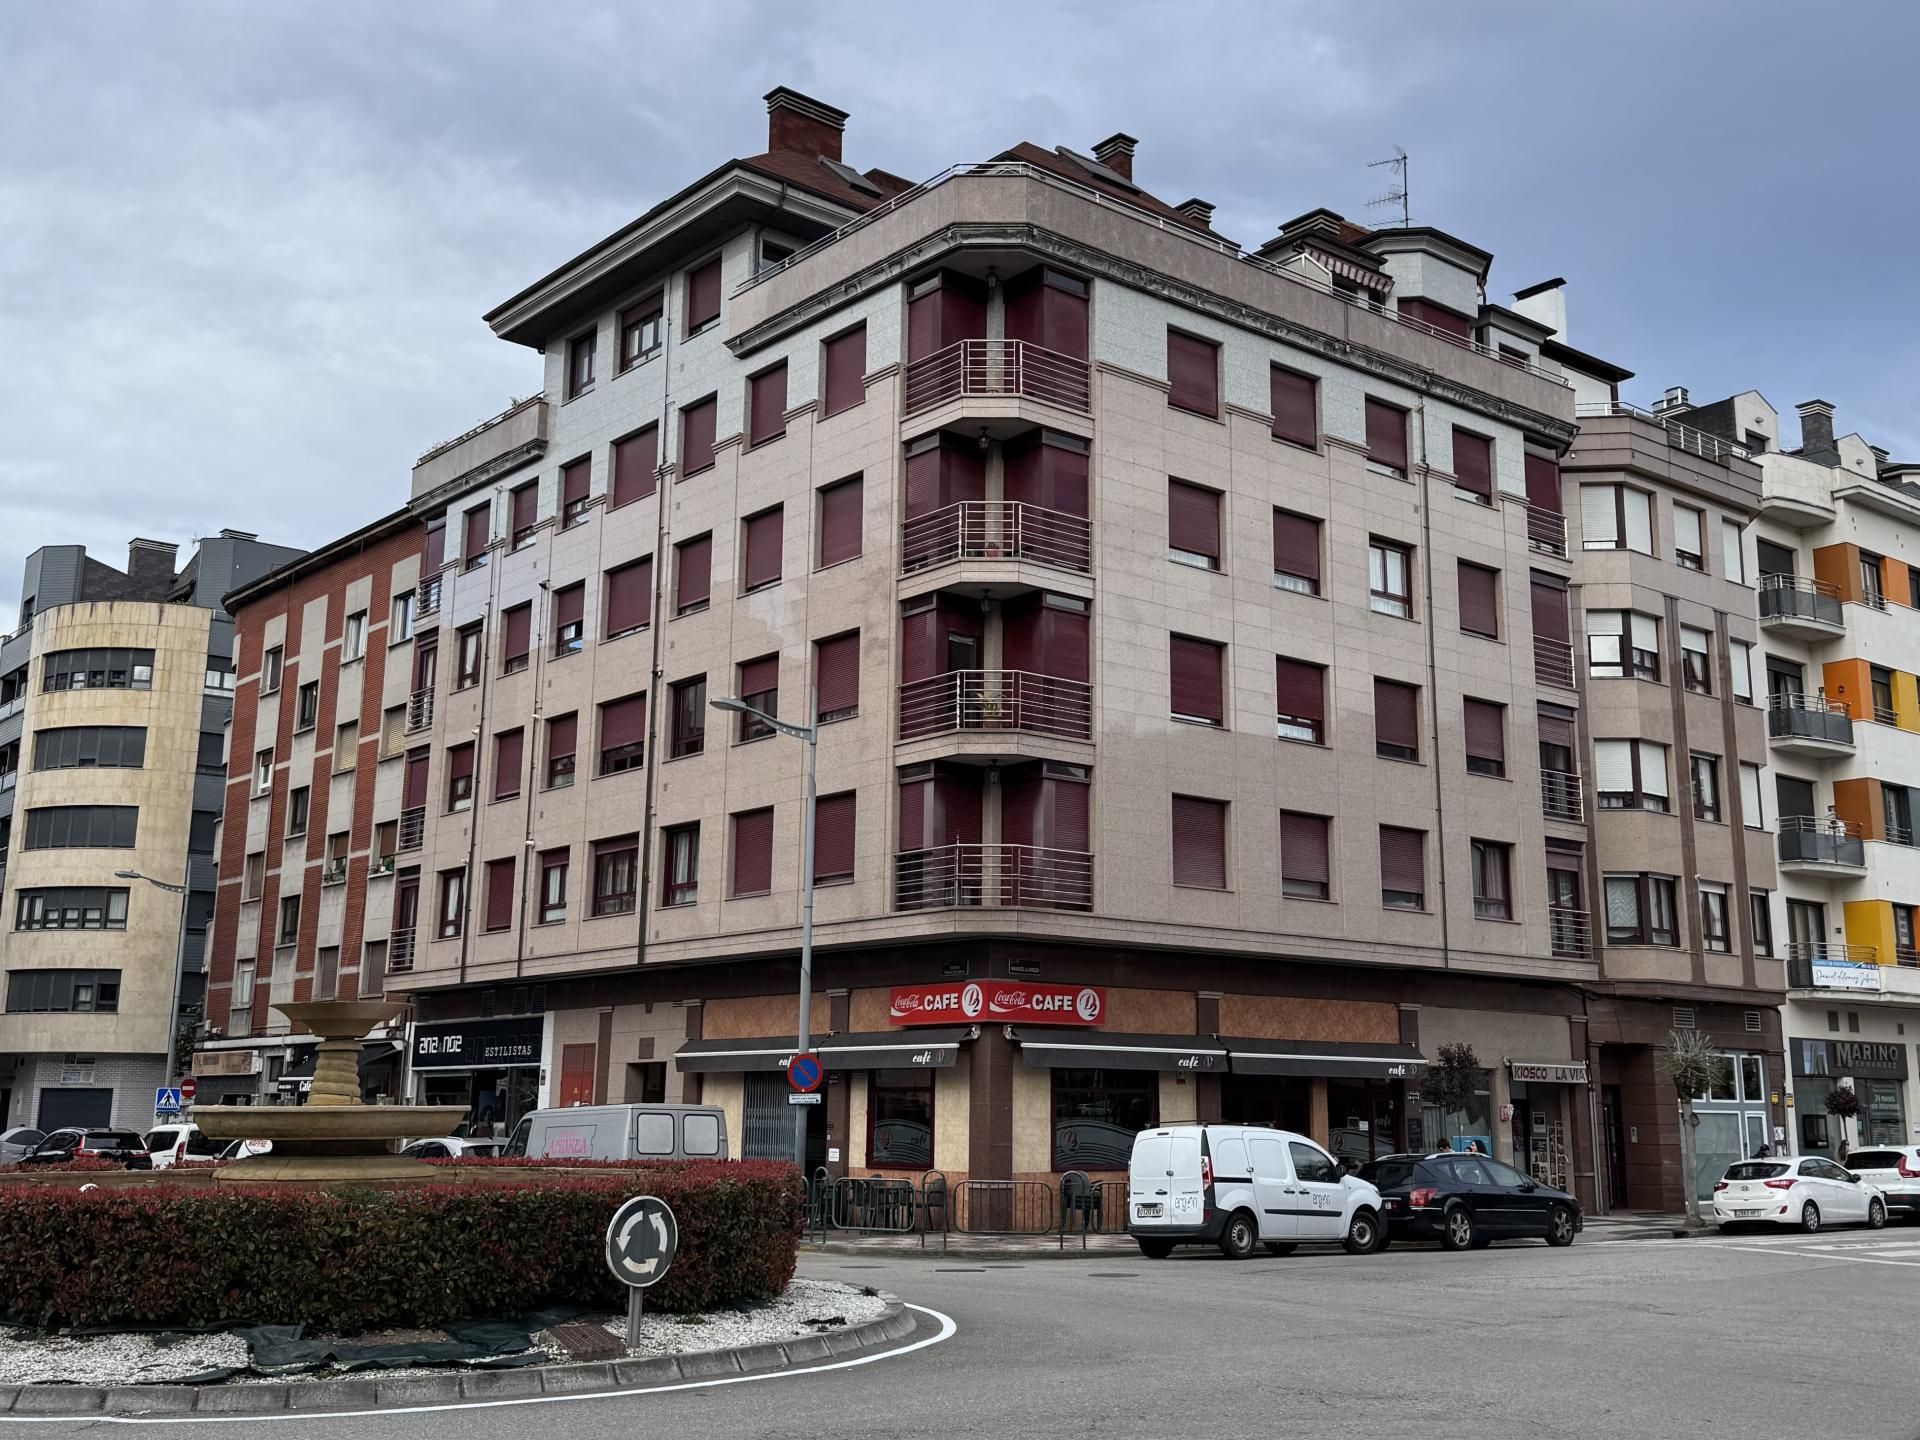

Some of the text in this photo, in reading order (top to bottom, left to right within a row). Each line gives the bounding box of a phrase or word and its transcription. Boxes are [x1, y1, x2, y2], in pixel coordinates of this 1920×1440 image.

[924, 993, 958, 1011] CAFE
[1032, 994, 1073, 1011] CAFE
[485, 1045, 532, 1057] ESTILISTAS
[1835, 1042, 1898, 1067] MARINO
[779, 1055, 795, 1068] caf
[1514, 1066, 1547, 1080] KIOSCO
[1555, 1068, 1567, 1080] LA
